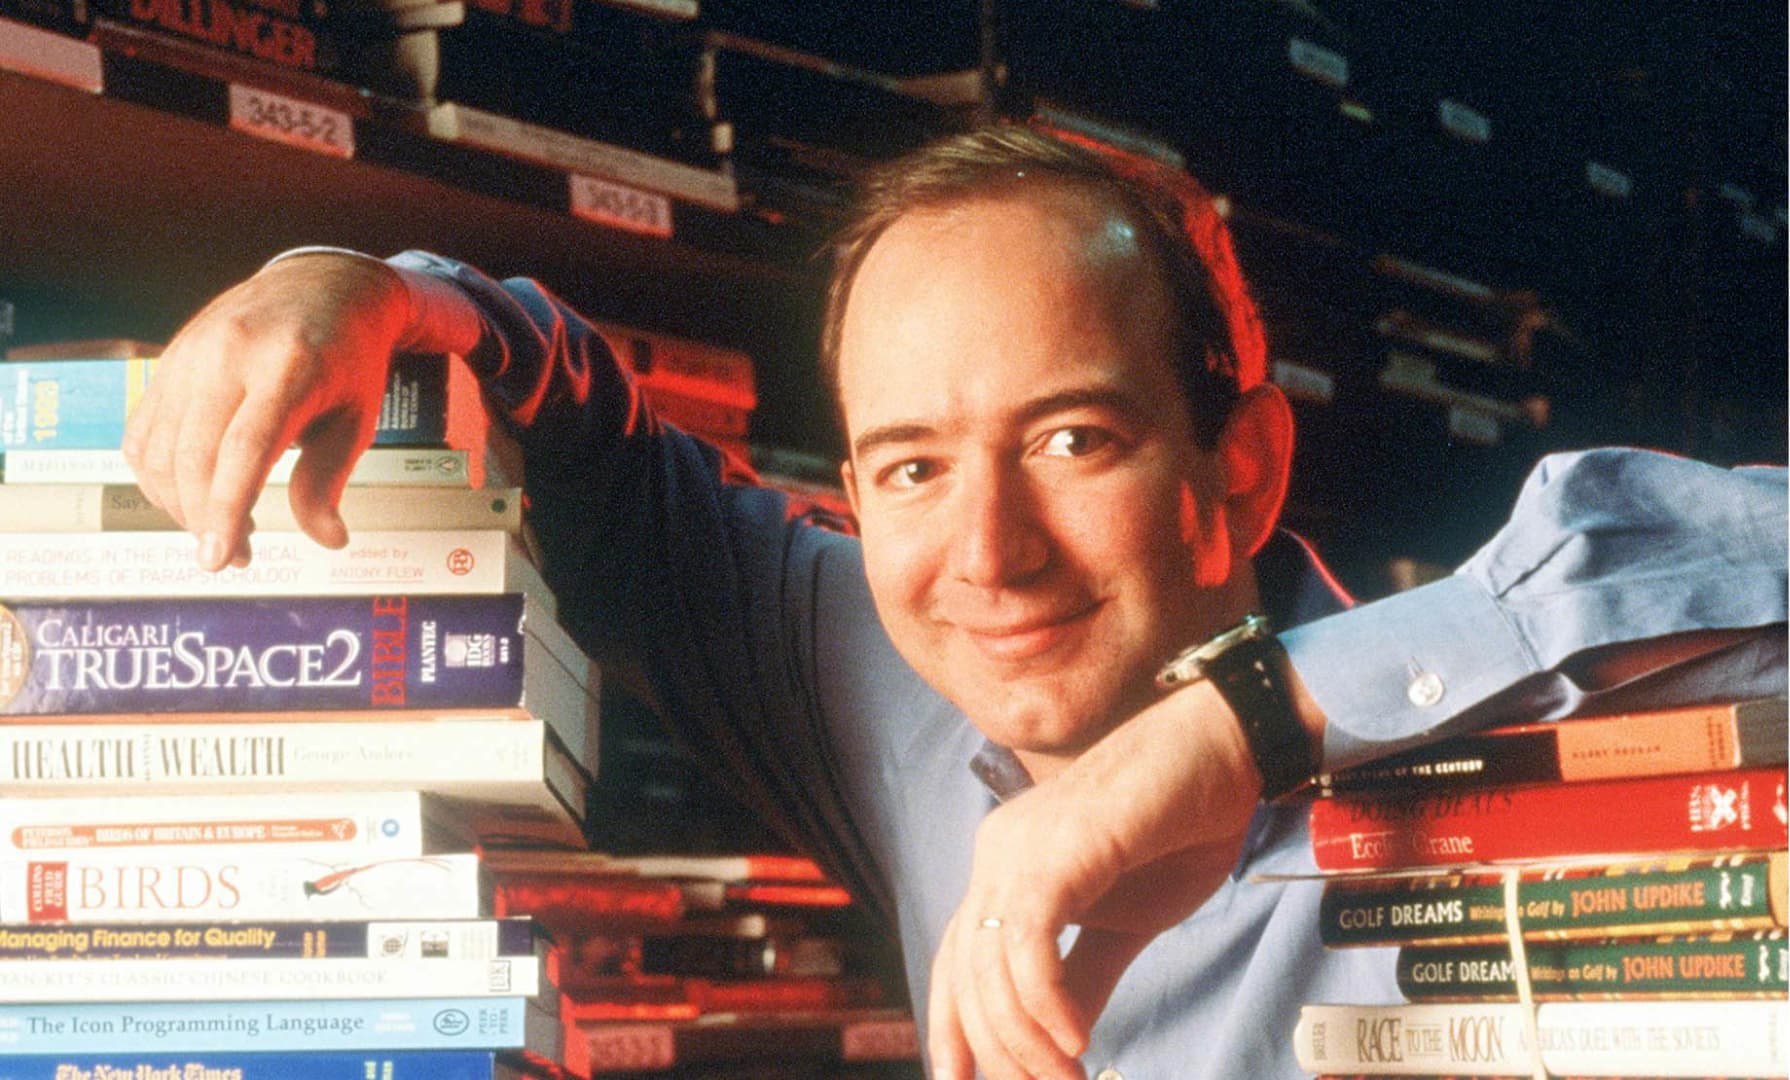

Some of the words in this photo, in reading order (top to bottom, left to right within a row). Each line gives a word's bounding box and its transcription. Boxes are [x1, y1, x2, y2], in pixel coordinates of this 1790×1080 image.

[249, 96, 337, 147] 343-5-2
[165, 544, 304, 562] PHIHICAL
[36, 618, 170, 648] CALIGARI
[371, 594, 409, 705] BIBLE
[13, 739, 135, 779] HEALTH
[160, 737, 285, 777] WEALTH
[78, 865, 241, 910] BIRDS
[1340, 906, 1385, 929] GOLF
[1391, 900, 1464, 926] DREAMS
[1571, 888, 1628, 919] JOHN
[1633, 880, 1706, 911] UPDIKE
[92, 929, 171, 948] Finance
[174, 928, 202, 947] for
[204, 927, 276, 949] Quality
[1412, 962, 1454, 983] GOLF
[1459, 960, 1517, 983] DREAM
[1622, 955, 1674, 984] JOHN
[1679, 953, 1747, 981] UPDIKE
[27, 1016, 65, 1035] The
[72, 1015, 115, 1034] Icon
[121, 1013, 260, 1038] Programming
[266, 1011, 365, 1036] Language
[1356, 1017, 1404, 1063] RACE
[1449, 1015, 1505, 1063] MOON
